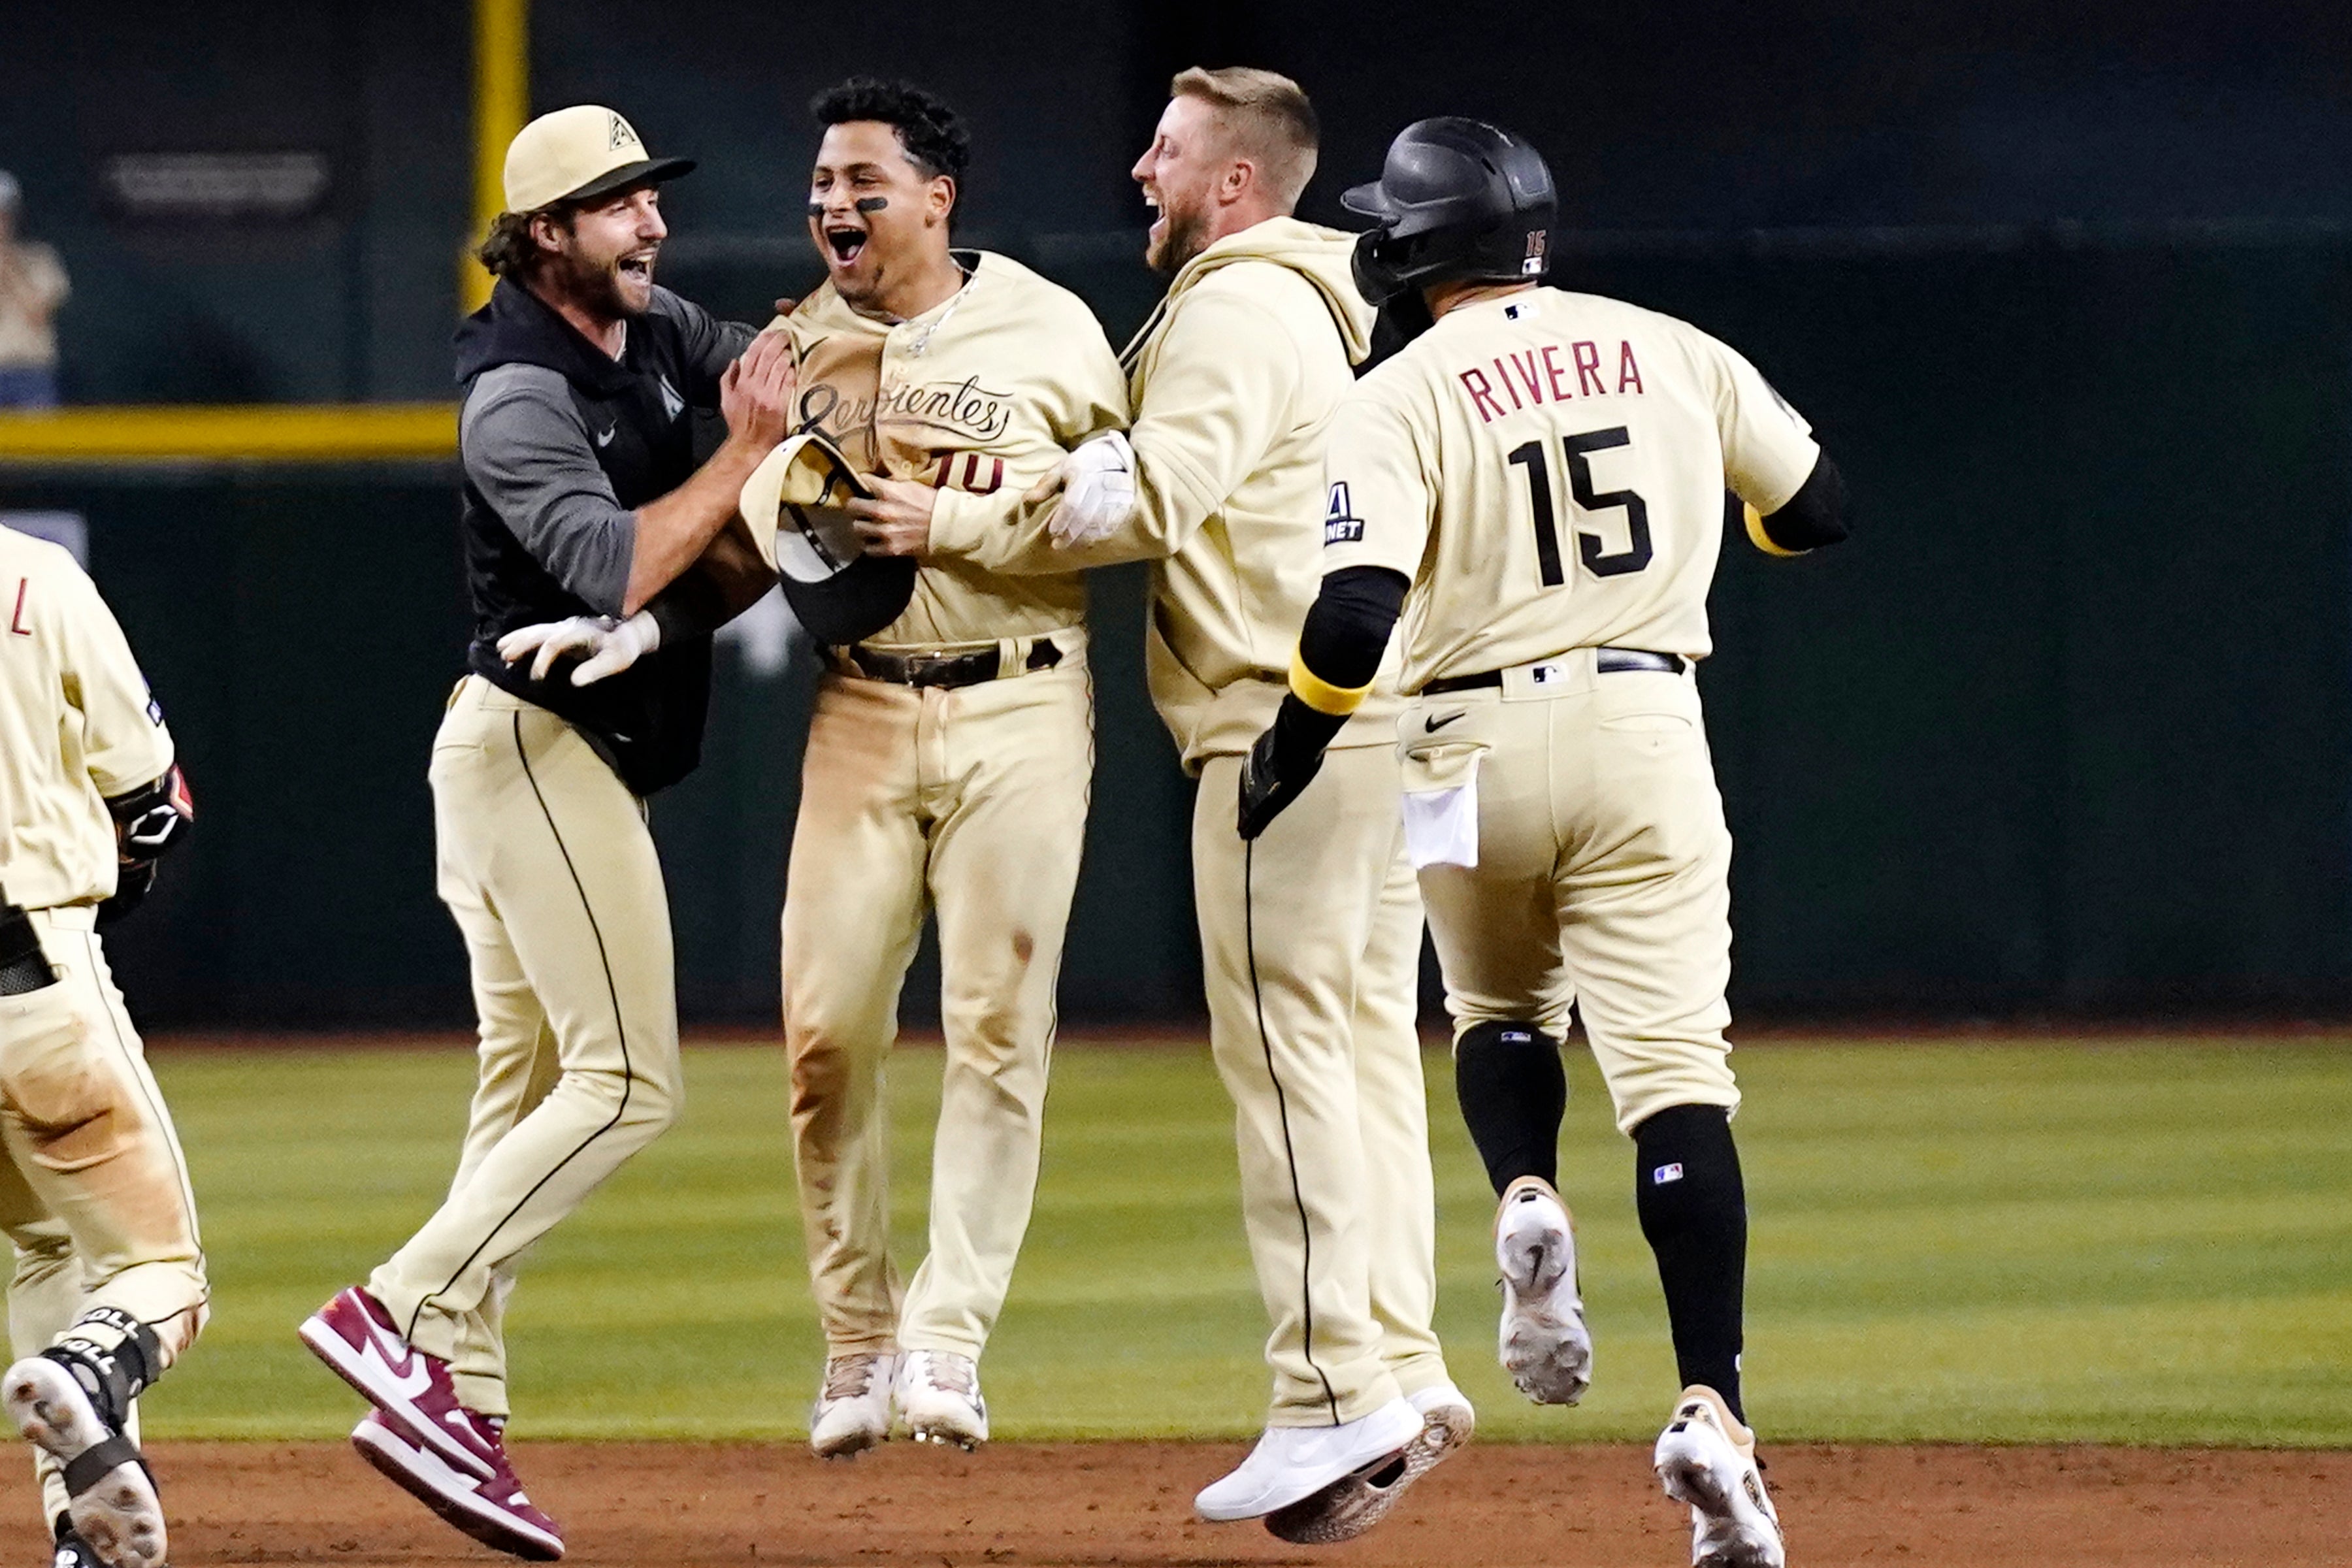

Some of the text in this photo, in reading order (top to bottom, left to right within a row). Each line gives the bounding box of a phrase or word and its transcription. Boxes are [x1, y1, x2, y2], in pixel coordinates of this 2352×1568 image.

[1526, 230, 1546, 257] 15
[1459, 340, 1643, 423] RIVERA
[798, 374, 1014, 463] Serpientes
[1508, 426, 1654, 587] 15
[85, 1307, 140, 1339] OLL
[58, 1339, 116, 1375] OLL
